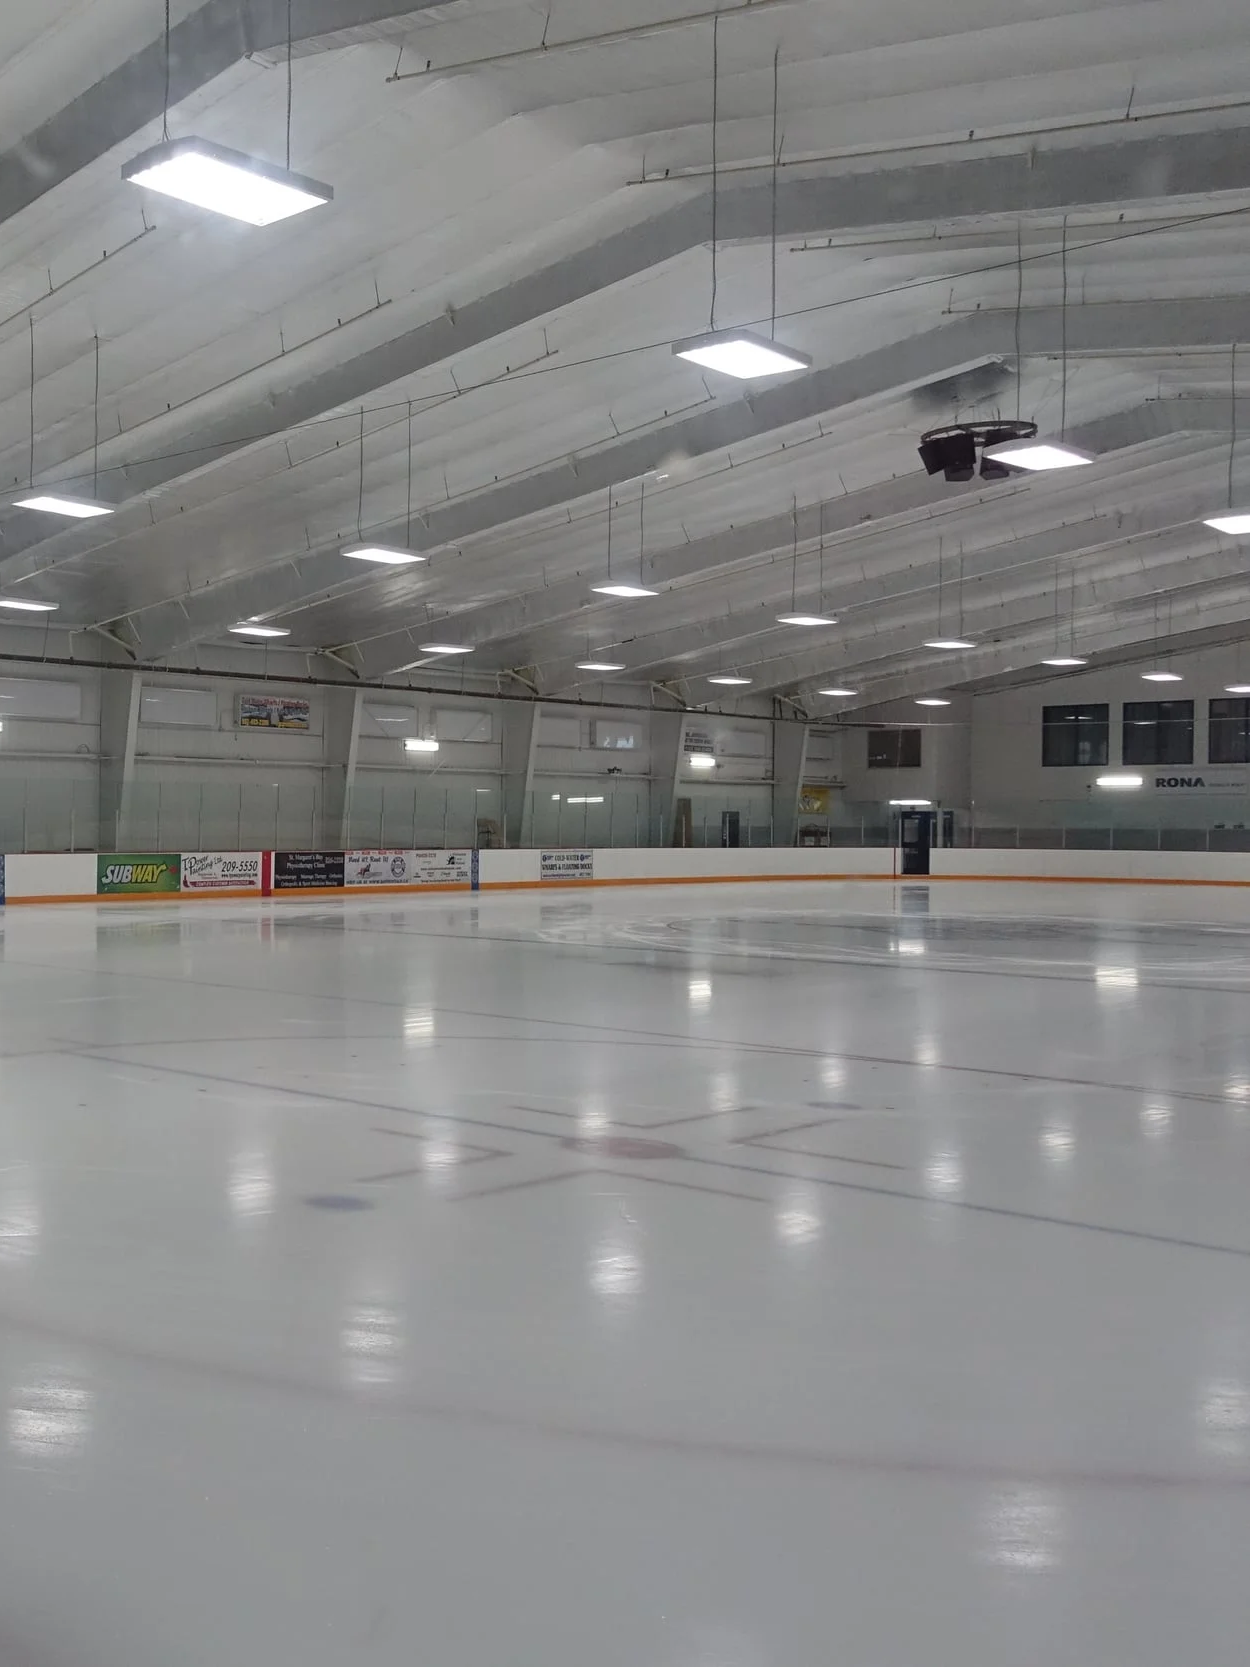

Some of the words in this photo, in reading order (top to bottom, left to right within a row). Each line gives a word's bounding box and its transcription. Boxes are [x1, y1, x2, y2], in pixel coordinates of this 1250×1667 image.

[1155, 777, 1206, 788] RONA
[221, 861, 258, 872] 209-5550
[101, 863, 167, 884] SUBWAY
